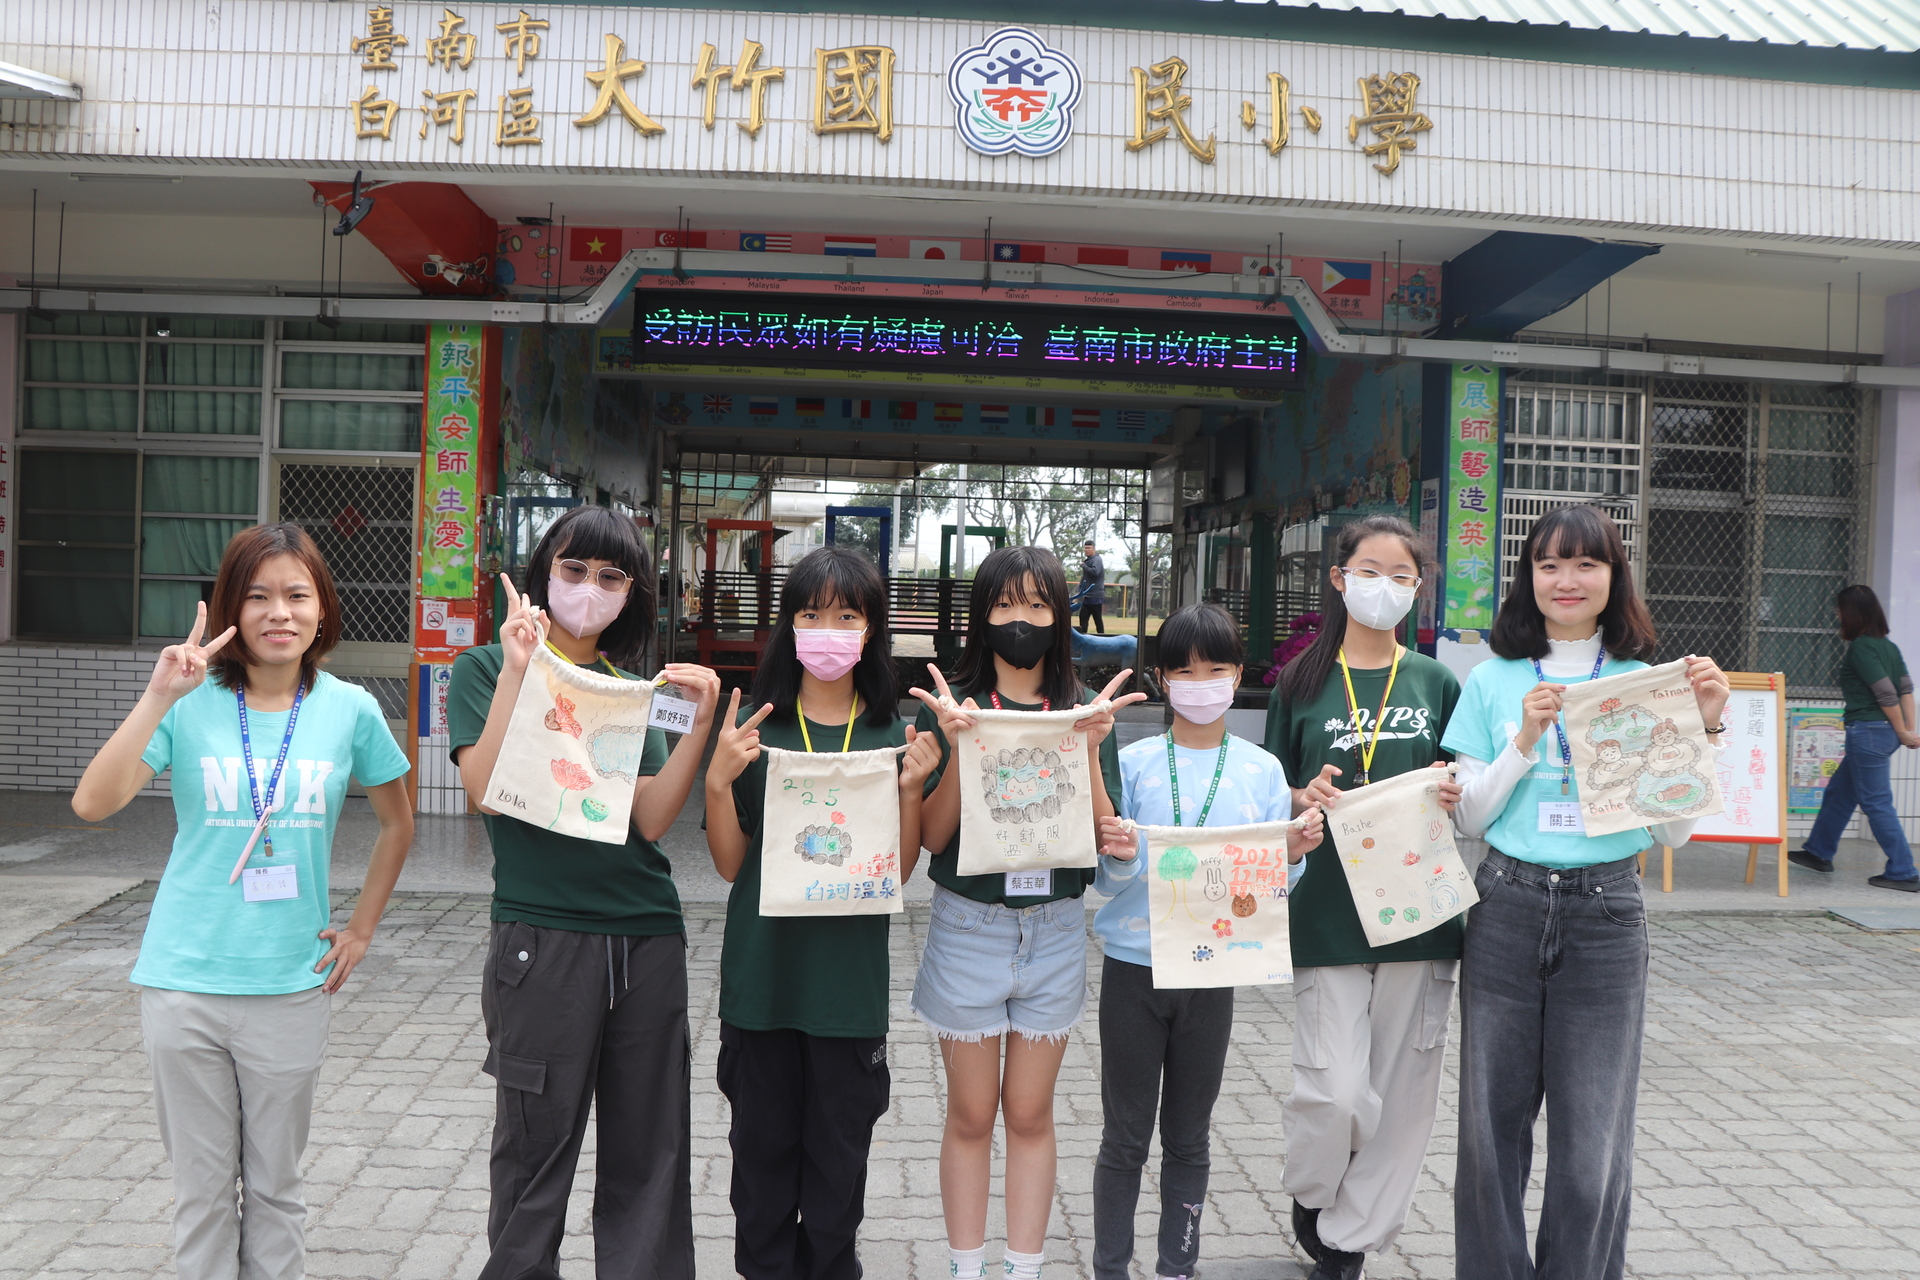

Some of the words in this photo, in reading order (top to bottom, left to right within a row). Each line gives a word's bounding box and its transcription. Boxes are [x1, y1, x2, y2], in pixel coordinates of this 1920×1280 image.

[351, 6, 550, 77] 臺南市
[350, 84, 544, 147] 白河區
[657, 278, 696, 287] Singapore
[747, 281, 781, 290] Malaysia
[833, 284, 865, 292] Thailand
[921, 288, 944, 296] Japan
[1004, 292, 1030, 300] Taiwan
[1083, 295, 1120, 304] Indonesia
[1165, 299, 1202, 309] Cambodia
[1328, 297, 1362, 309] 菲律賓
[1255, 304, 1276, 312] Korea
[1326, 308, 1364, 318] Philippines
[433, 324, 473, 549] 報平安師生愛
[1649, 686, 1691, 701] Tainan
[200, 756, 334, 815] NUK
[279, 820, 288, 828] OF
[1549, 813, 1577, 827] 關主
[996, 824, 1060, 843] 好舒服
[1003, 842, 1050, 858] 溫泉
[1201, 857, 1222, 867] Miffy
[1233, 847, 1284, 869] 2025
[867, 852, 898, 878] 蓮花
[805, 877, 897, 901] 白河溫泉
[1011, 877, 1046, 890] 蔡玉華
